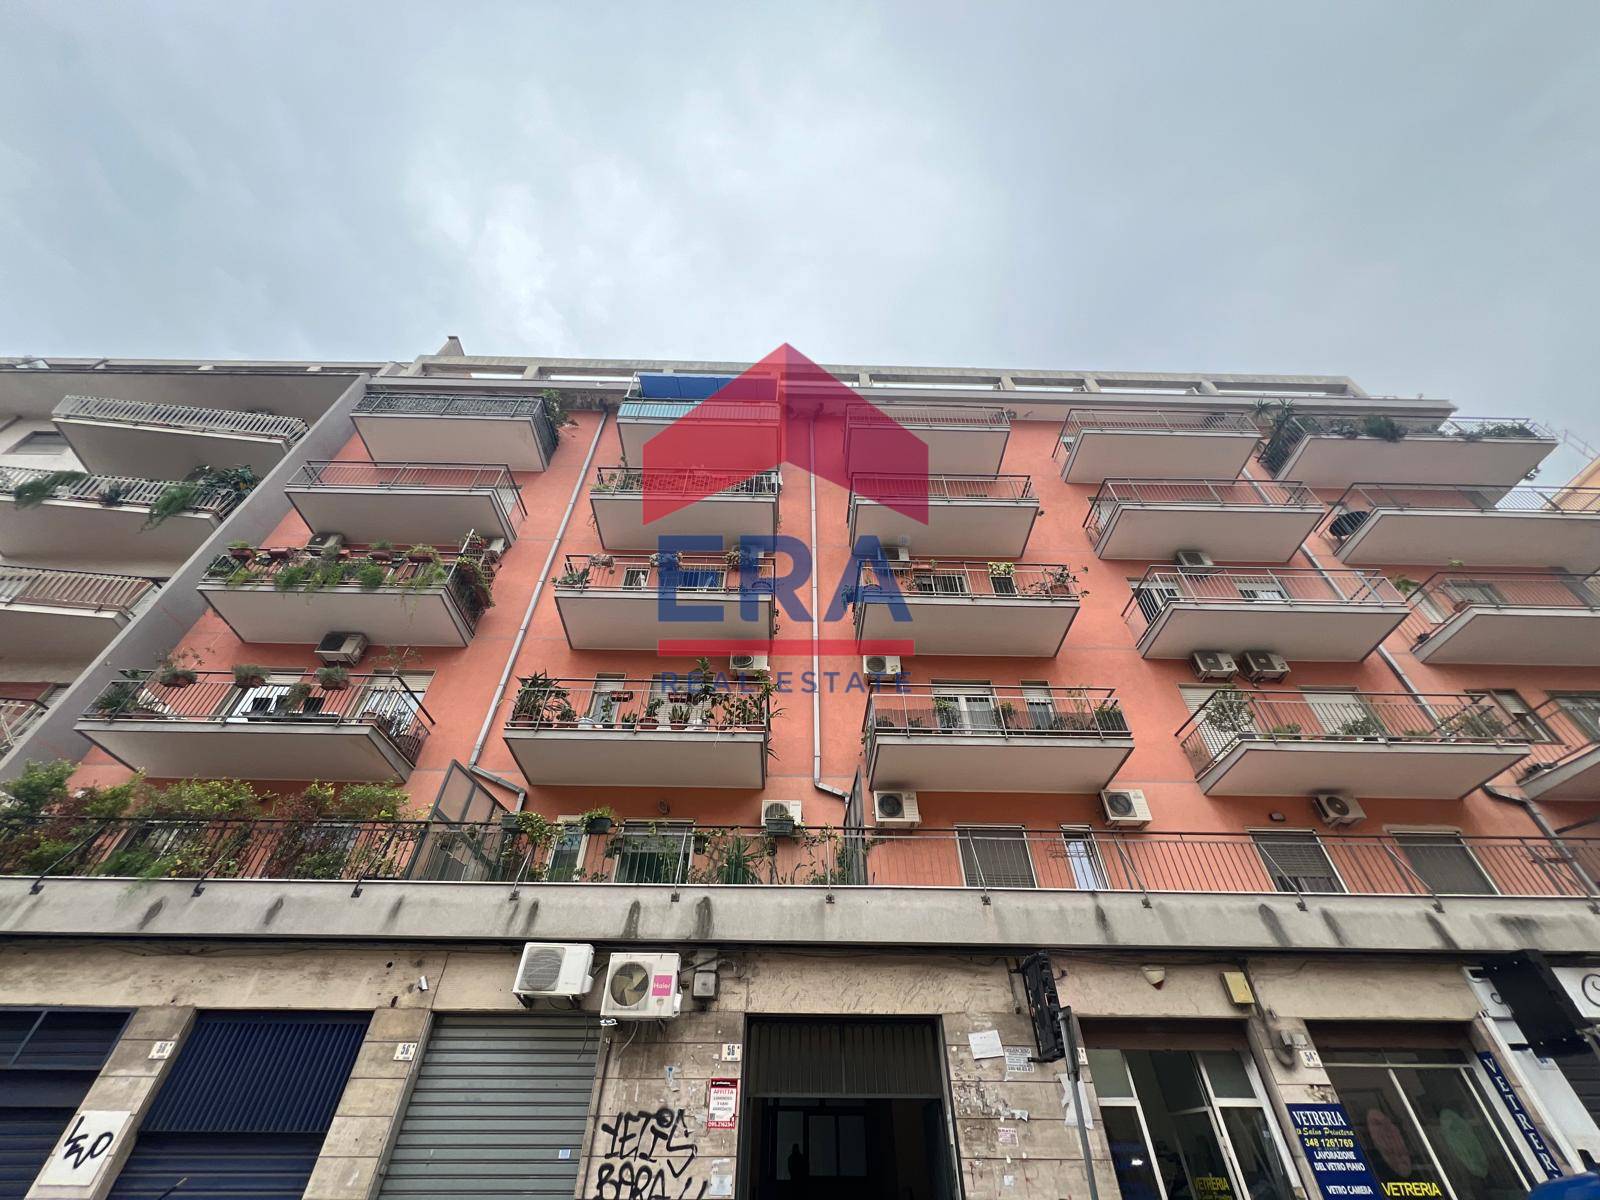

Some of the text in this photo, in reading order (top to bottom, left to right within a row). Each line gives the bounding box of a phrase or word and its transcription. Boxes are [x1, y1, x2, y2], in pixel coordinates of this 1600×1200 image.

[1292, 1110, 1347, 1126] VETRERIA
[1304, 1138, 1320, 1147] 348
[1321, 1138, 1355, 1148] 1261769
[1313, 1151, 1357, 1160] LAVORAZIONE
[1313, 1162, 1366, 1171] DEL VETRO PIANO
[1194, 1176, 1230, 1191] VETRERIA
[1325, 1185, 1374, 1195] VETRO CAMERA
[1380, 1182, 1442, 1196] VETRERIA
